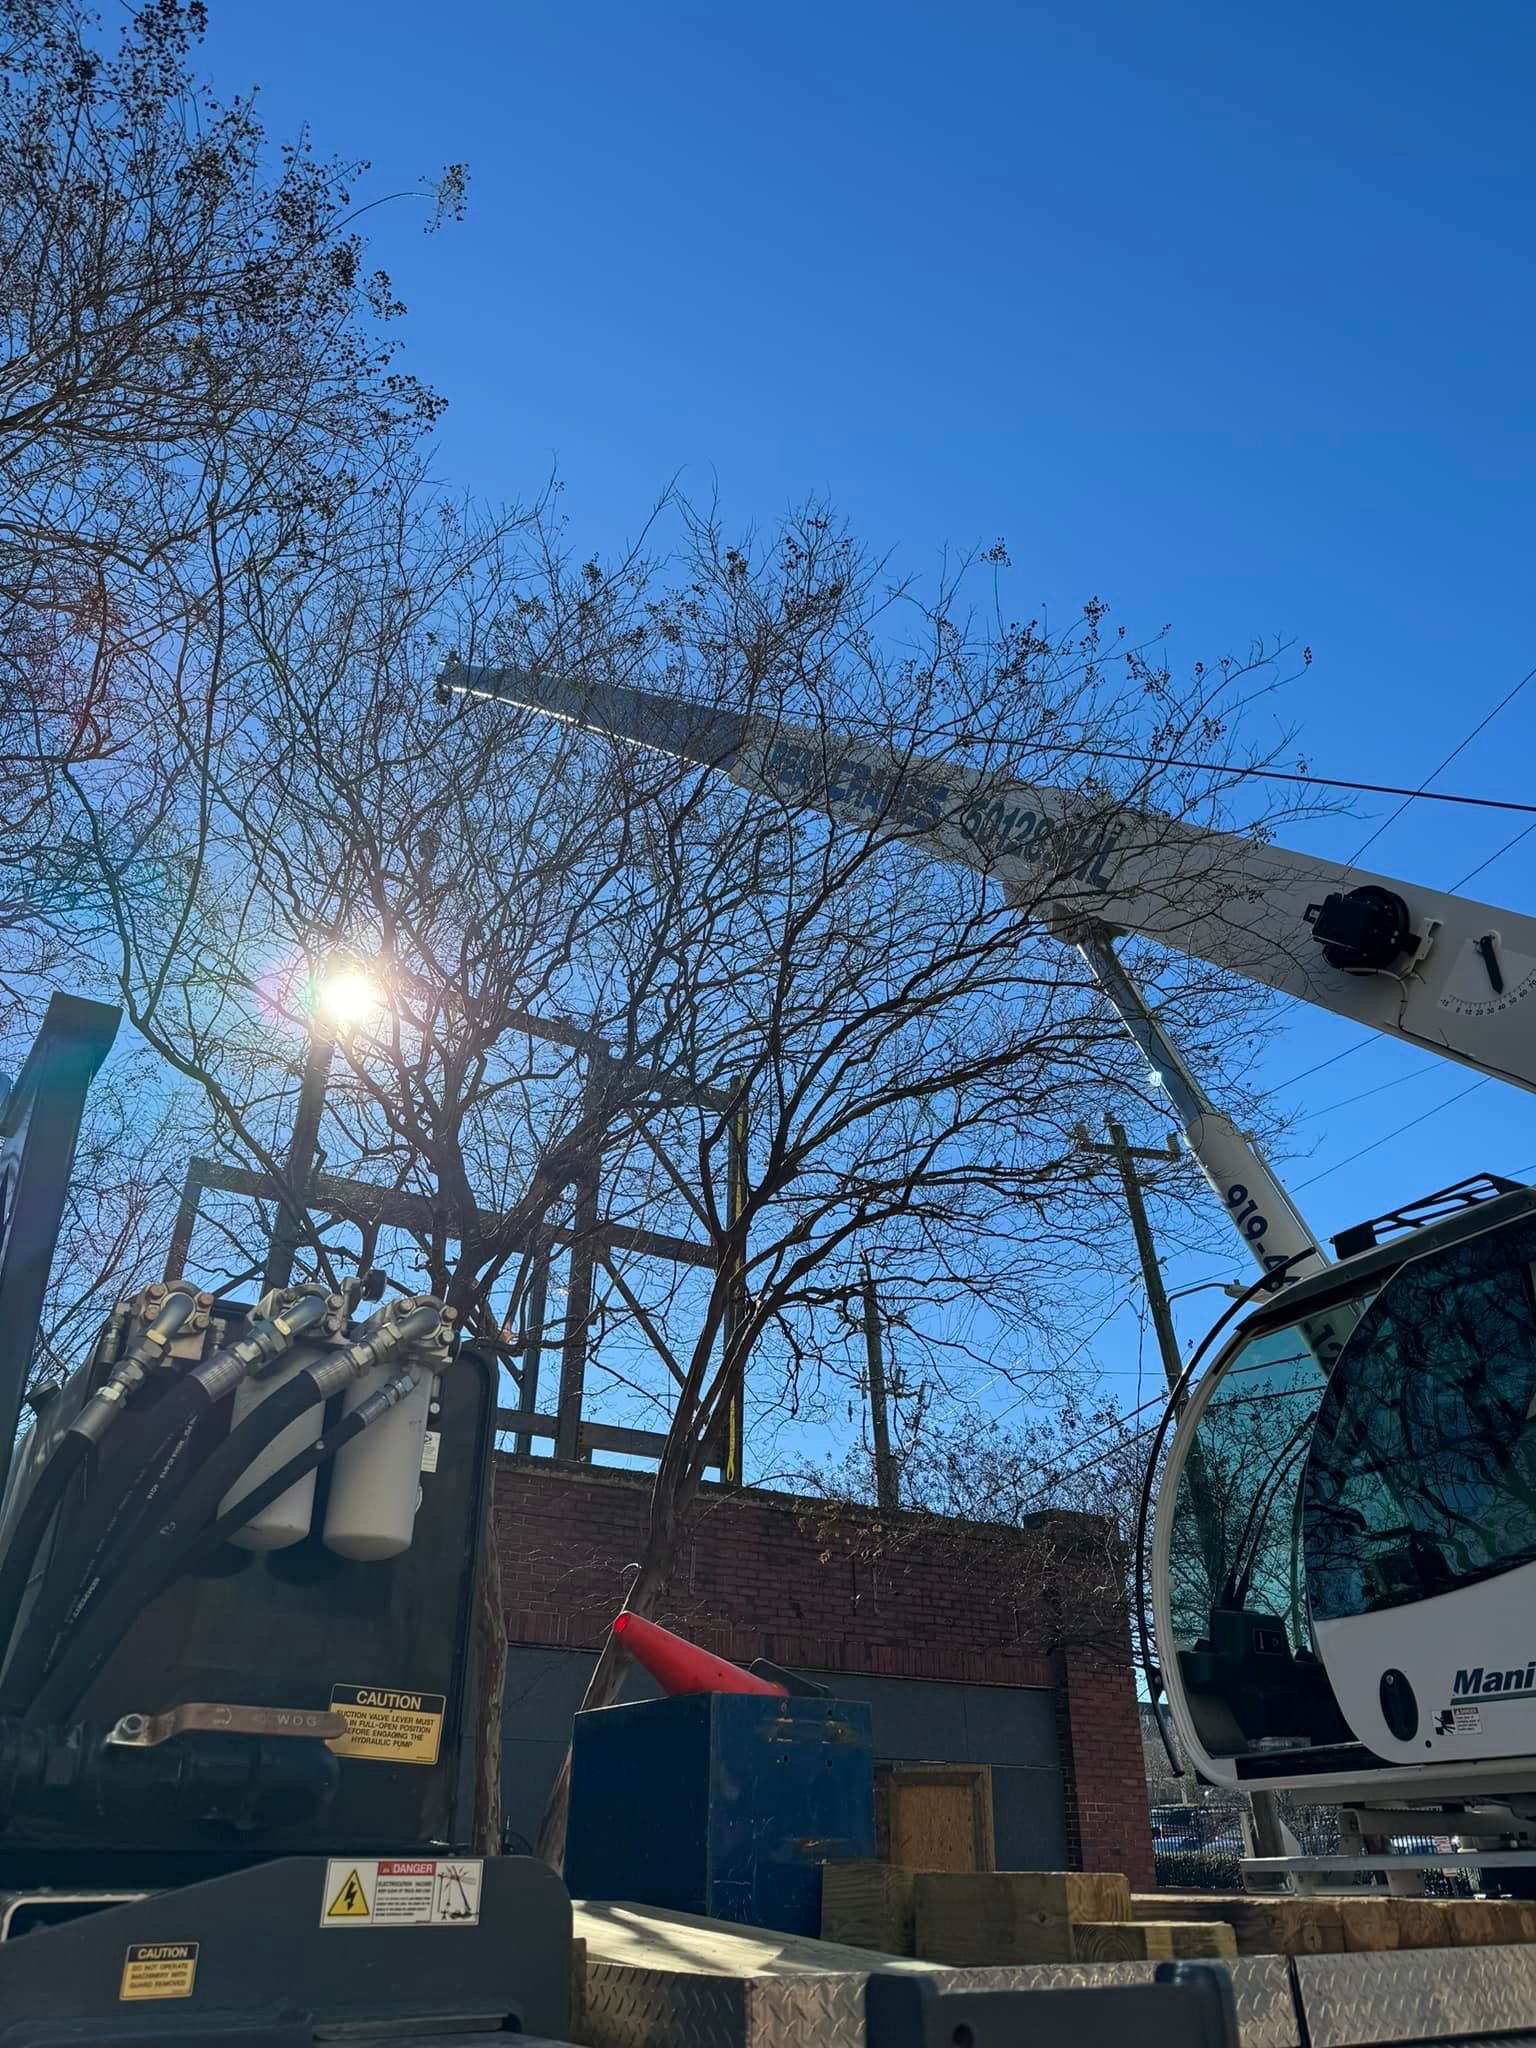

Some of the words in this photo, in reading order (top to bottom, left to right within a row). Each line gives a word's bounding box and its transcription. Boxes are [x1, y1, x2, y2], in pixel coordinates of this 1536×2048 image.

[356, 1690, 421, 1710] CAUTION
[369, 1713, 390, 1721] VALVE
[392, 1715, 414, 1724] LEVER
[416, 1718, 433, 1726] MUST
[360, 1721, 397, 1731] FULL-OPEN
[400, 1725, 431, 1733] POSITION
[373, 1729, 408, 1739] ENGAGING
[351, 1737, 390, 1746] HYDRAULIC
[393, 1740, 413, 1748] PUMP
[393, 1863, 433, 1873] DANGER
[138, 1947, 188, 1959] CAUTION
